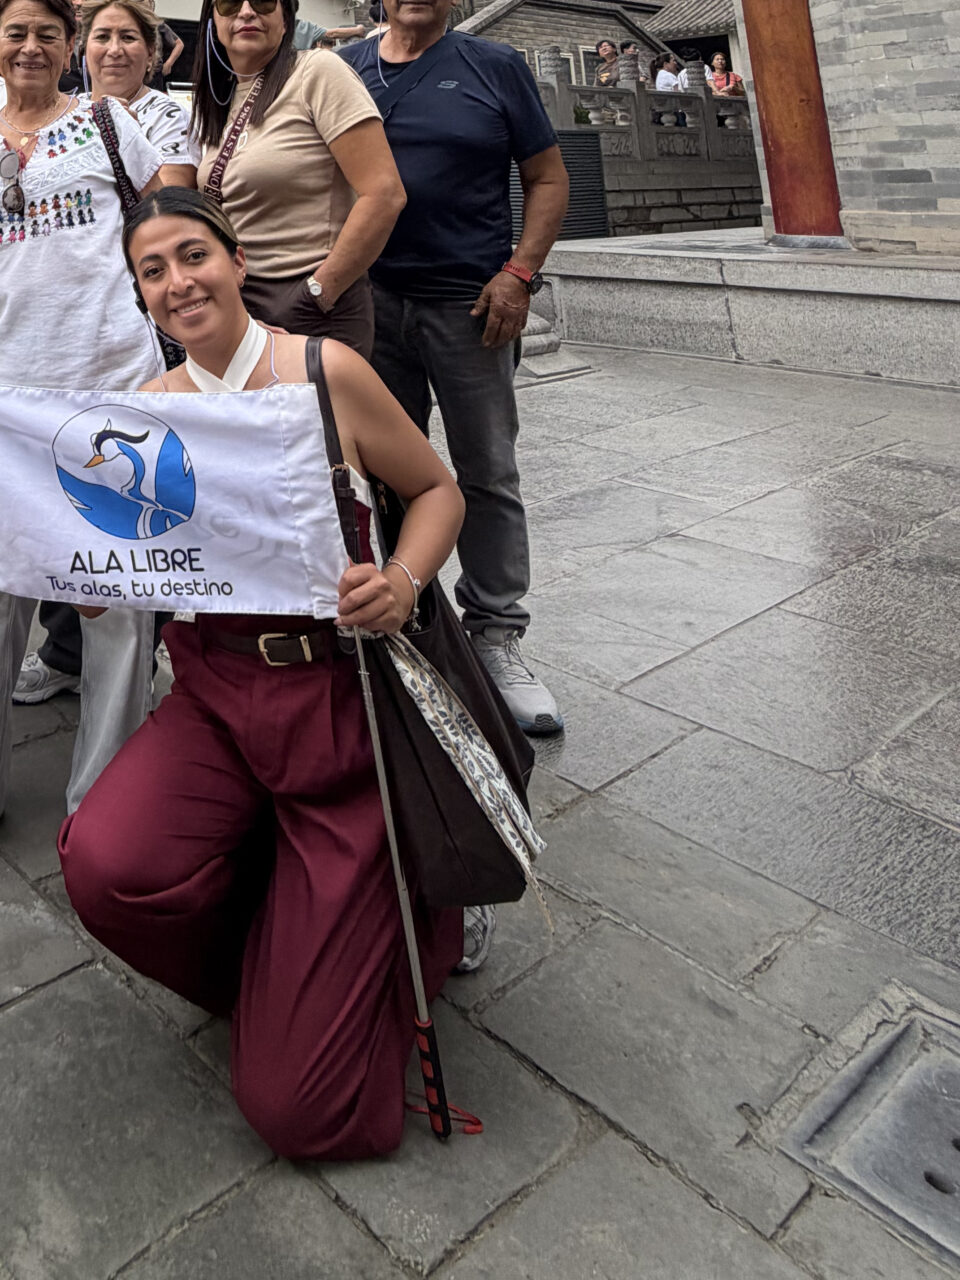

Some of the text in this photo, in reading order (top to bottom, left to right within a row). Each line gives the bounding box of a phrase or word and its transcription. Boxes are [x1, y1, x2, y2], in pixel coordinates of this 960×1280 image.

[70, 548, 205, 574] ALA LIBRE
[45, 576, 233, 600] Tus alas, tu destino
